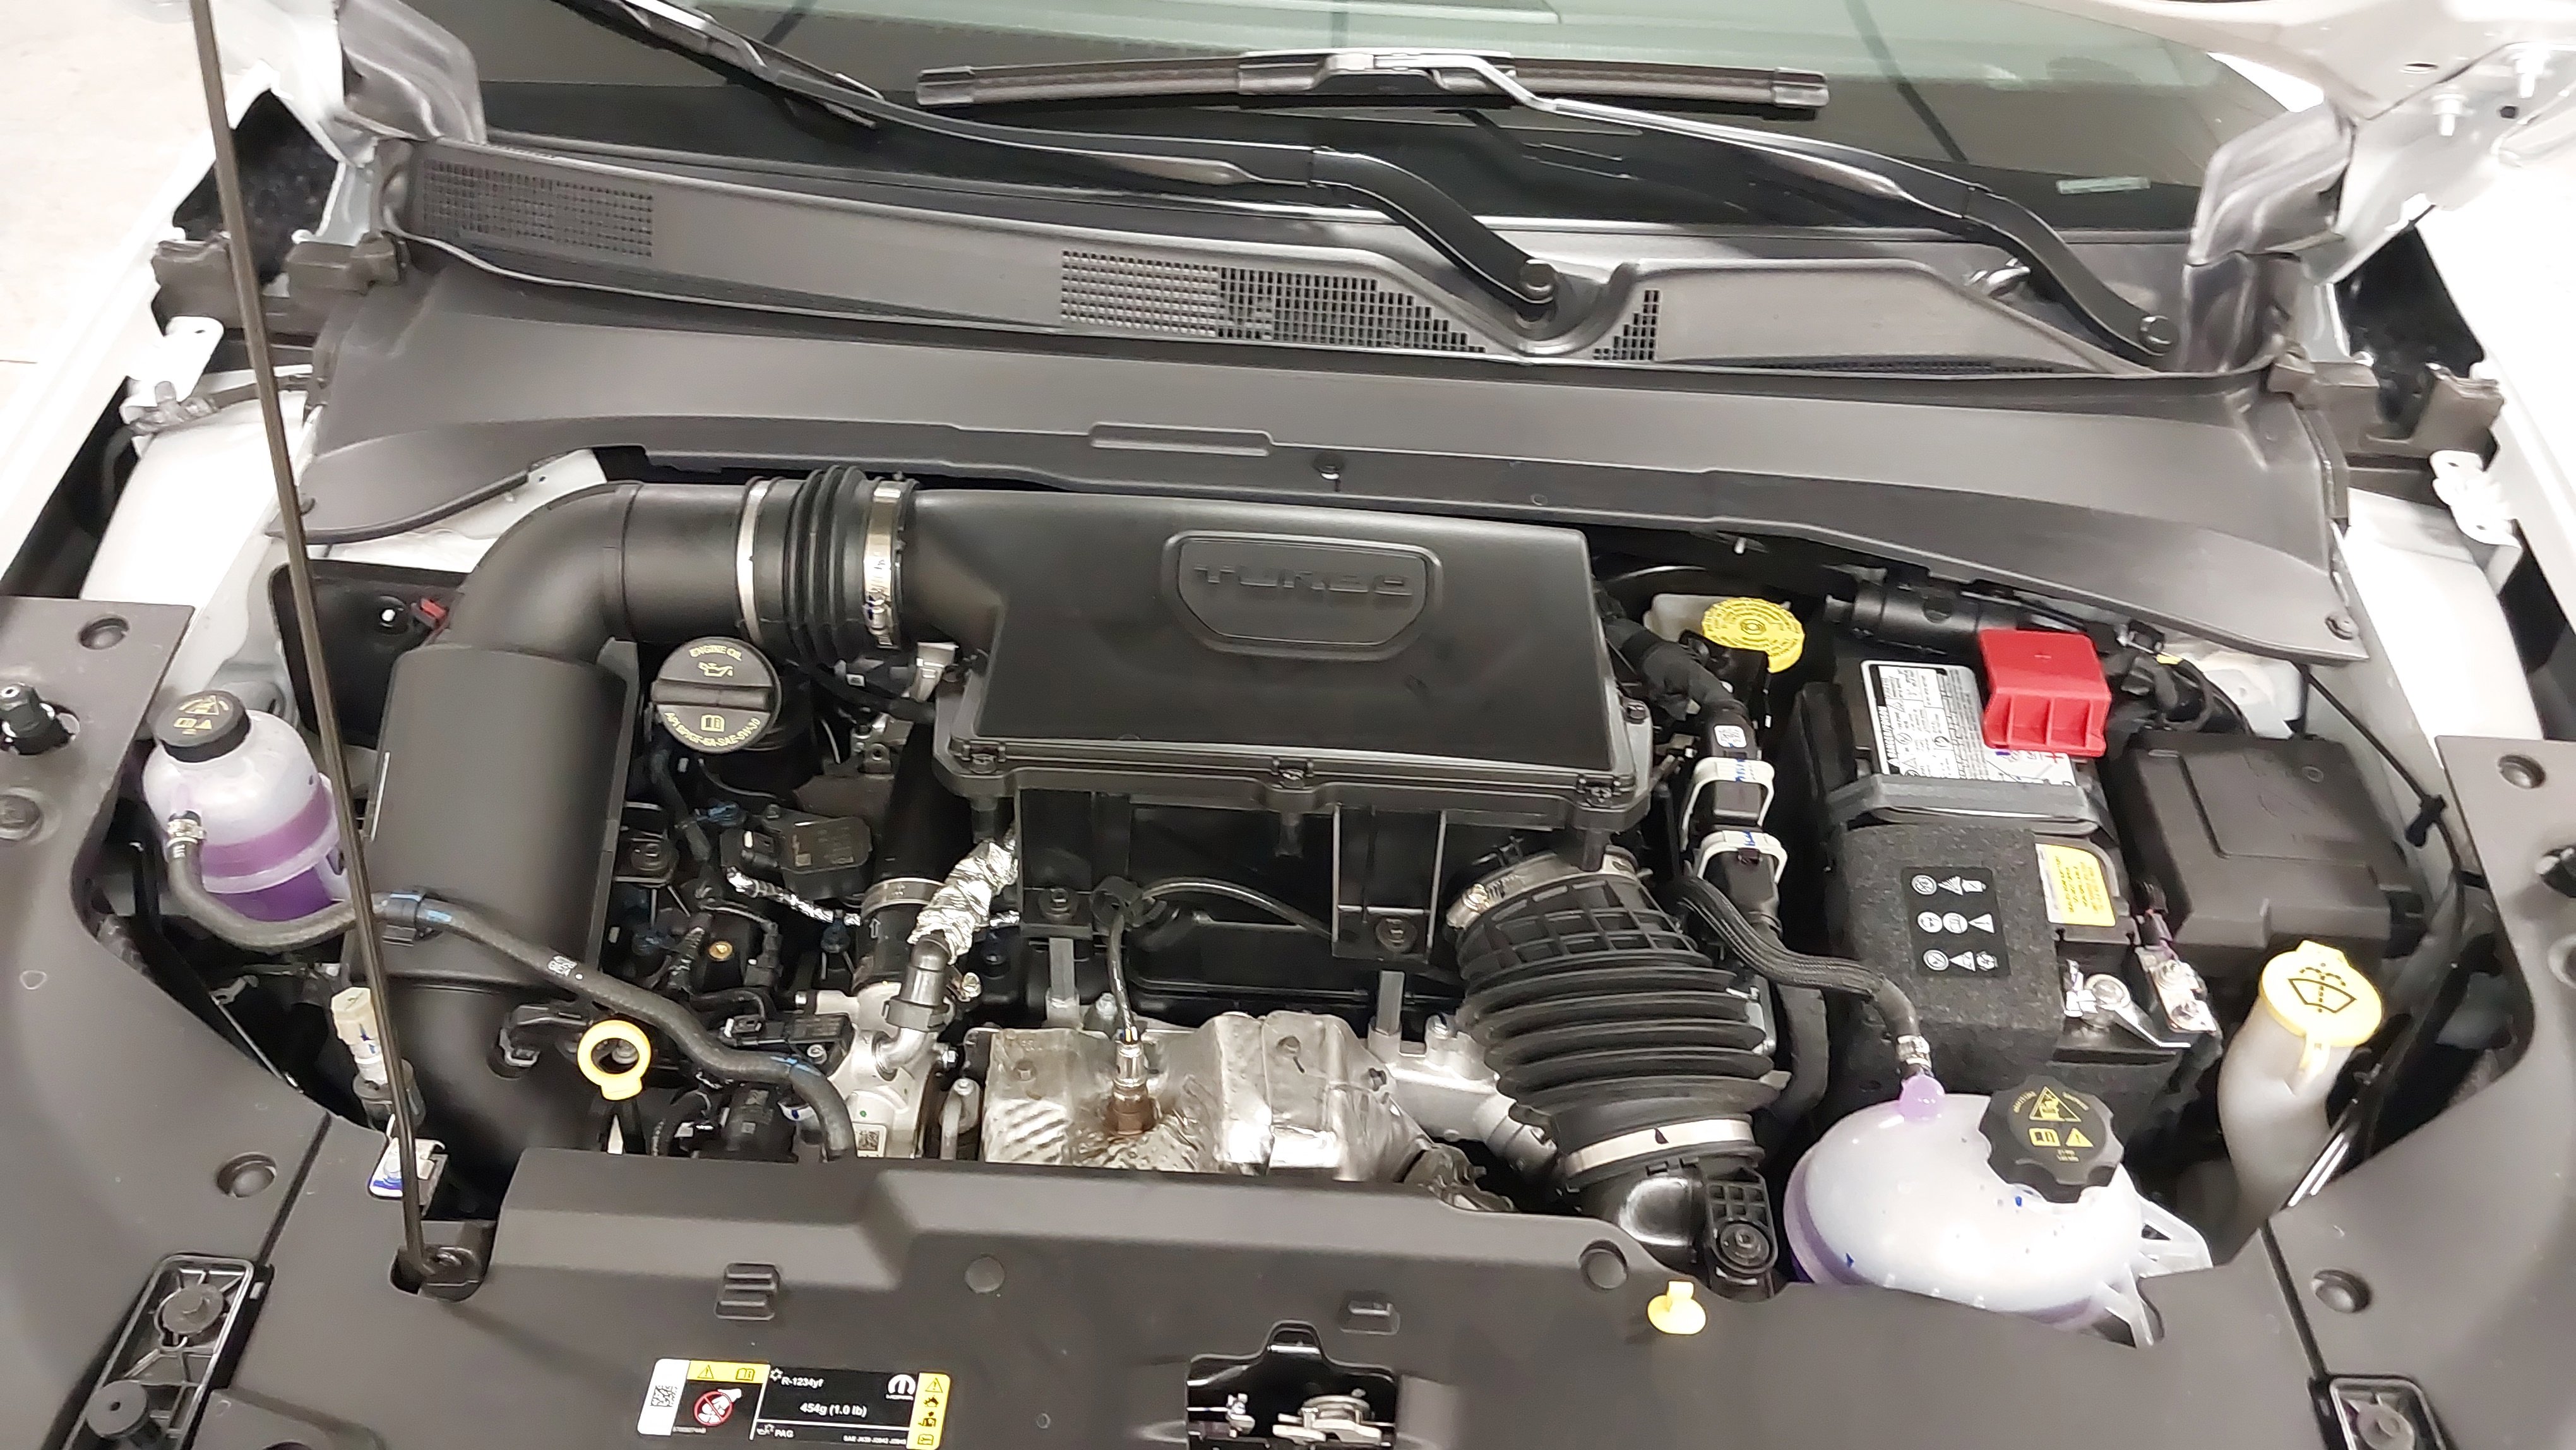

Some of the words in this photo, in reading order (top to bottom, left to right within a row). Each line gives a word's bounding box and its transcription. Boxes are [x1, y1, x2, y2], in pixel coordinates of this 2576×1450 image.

[689, 645, 727, 657] ENGINE
[726, 648, 742, 661] OIL
[781, 1376, 825, 1389] R-1234yf
[799, 1403, 828, 1416] 454g
[829, 1404, 850, 1417] (1.0
[852, 1405, 868, 1418] lb)
[774, 1429, 794, 1438] PAG
